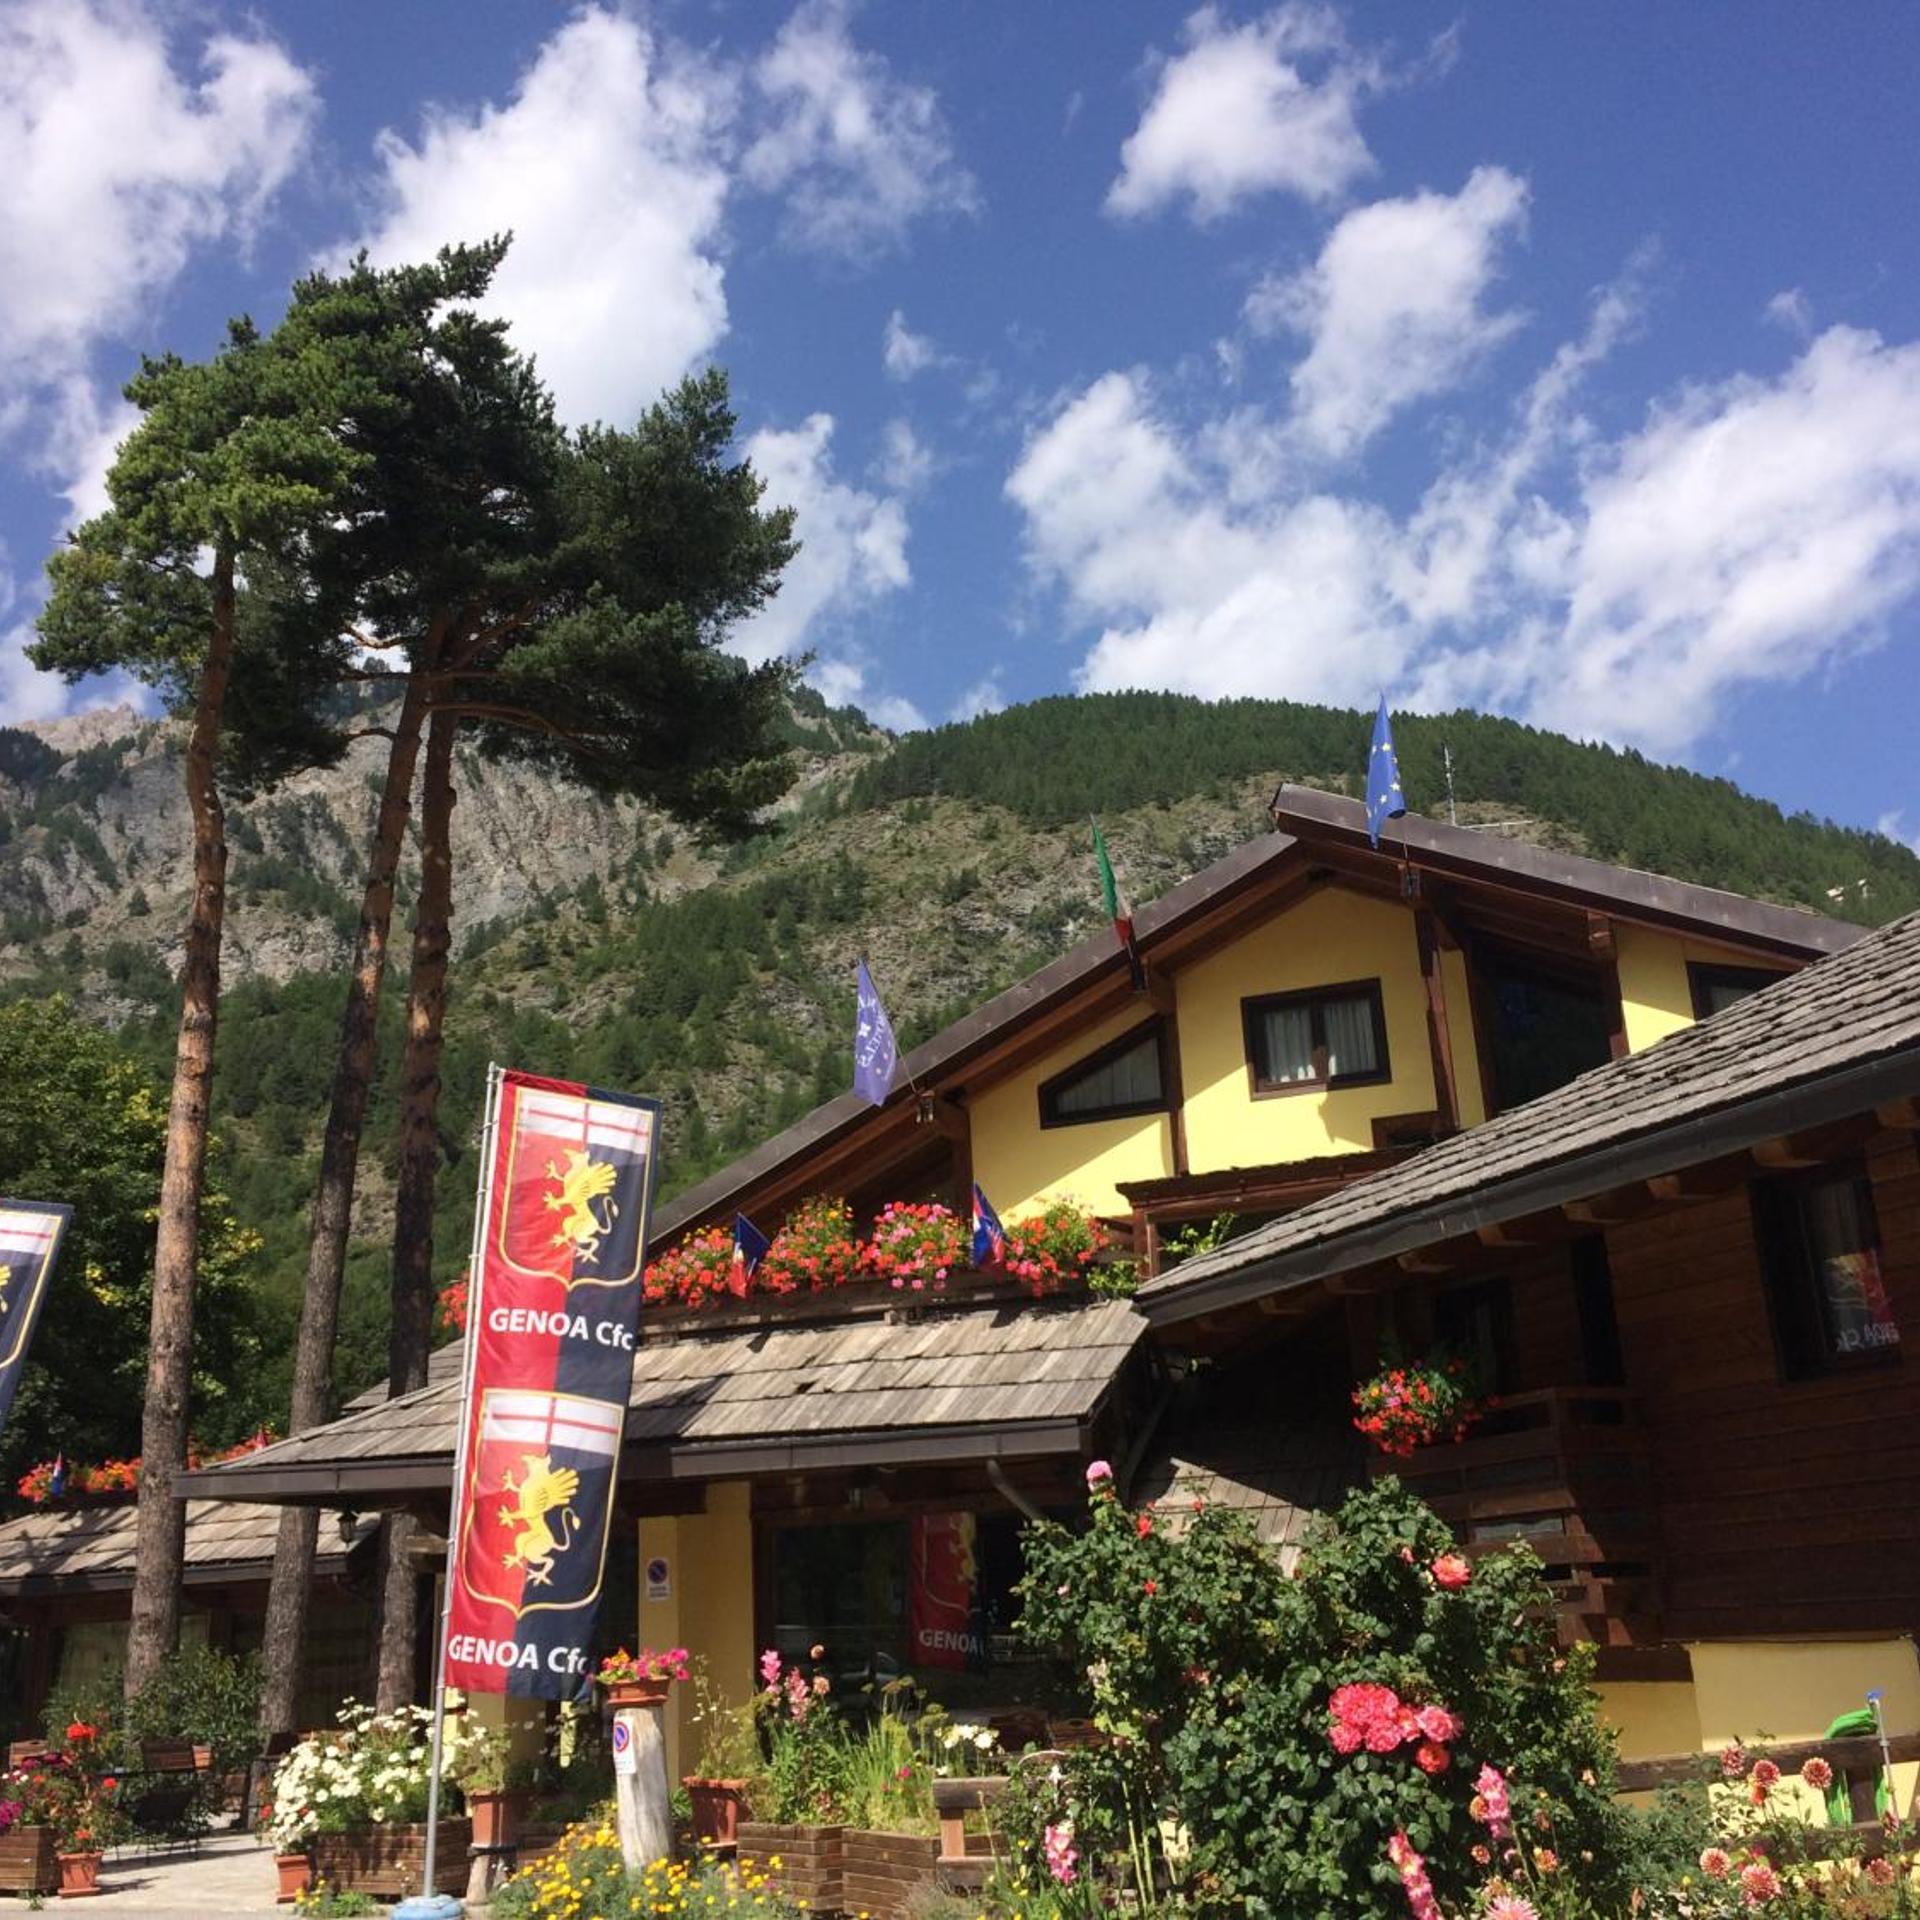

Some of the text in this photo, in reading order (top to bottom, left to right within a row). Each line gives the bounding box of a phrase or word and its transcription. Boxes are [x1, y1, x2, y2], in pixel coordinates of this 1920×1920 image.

[489, 1307, 633, 1350] GENOA Cfc
[448, 1634, 539, 1670] GENOA
[918, 1628, 978, 1656] GENOA
